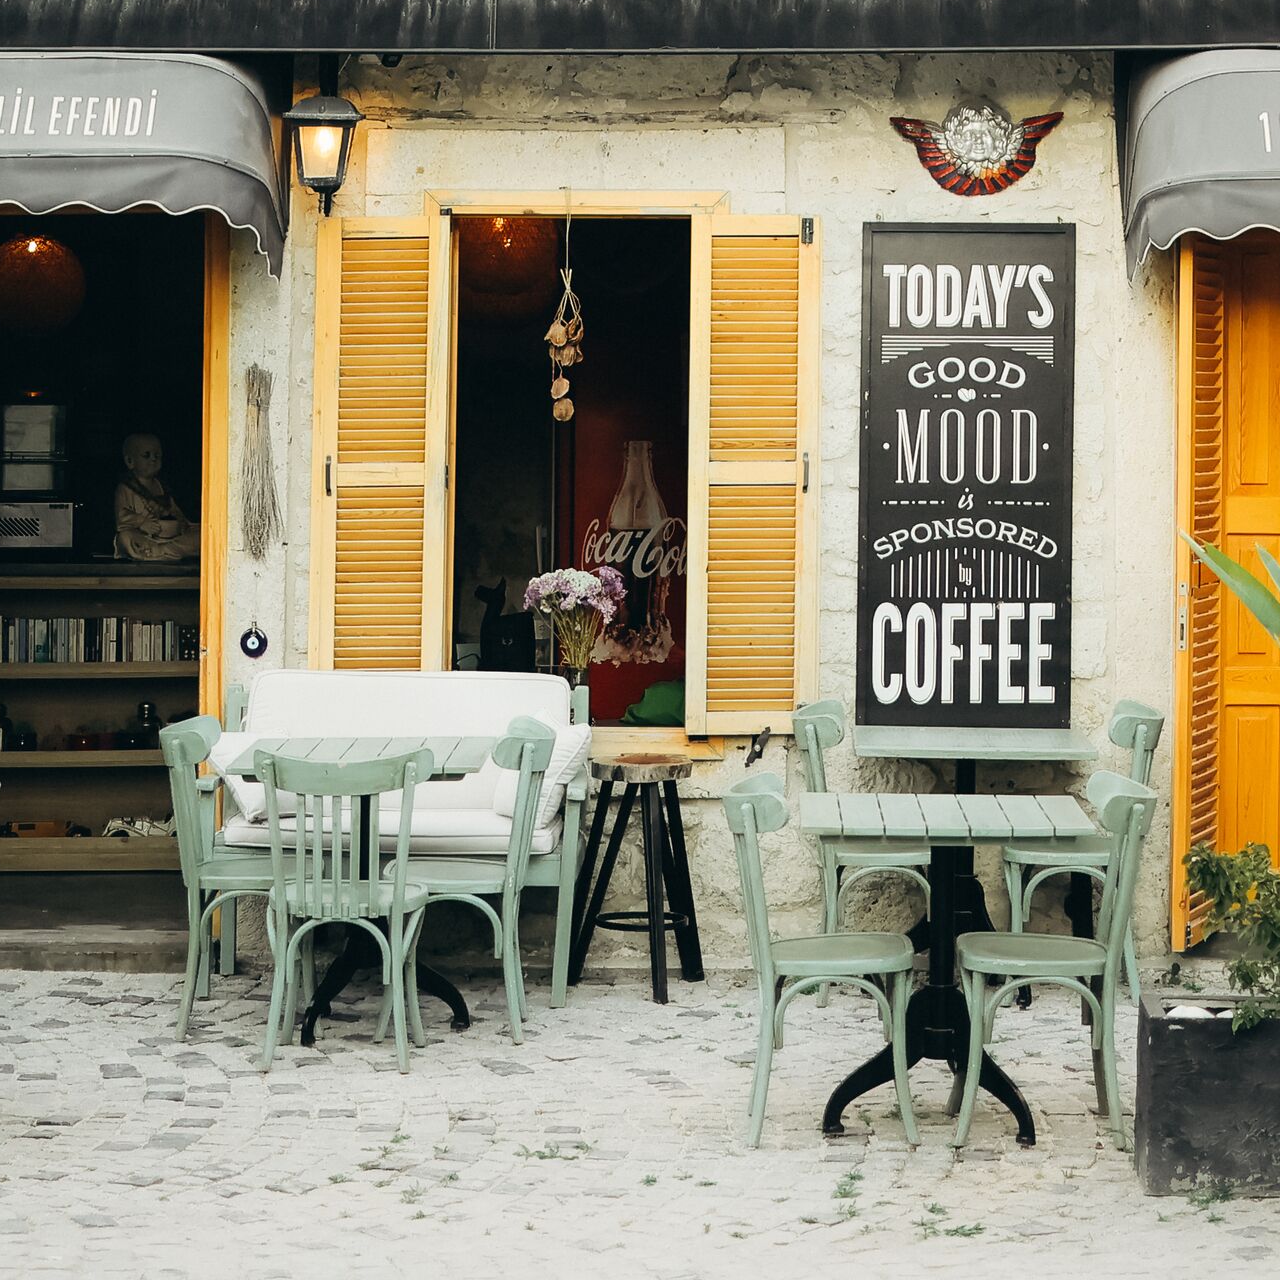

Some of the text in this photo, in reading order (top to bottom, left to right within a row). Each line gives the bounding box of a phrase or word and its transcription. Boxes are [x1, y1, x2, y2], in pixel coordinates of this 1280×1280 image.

[47, 89, 158, 137] EFENDİ
[882, 263, 1055, 329] TODAY'S
[907, 356, 1027, 389] GOOD
[894, 408, 1038, 485] MOOD
[957, 487, 974, 511] is
[581, 517, 687, 578] Coca-Col
[872, 518, 1059, 560] SPONSORED
[958, 563, 972, 586] by
[871, 601, 1057, 705] COFFEE
